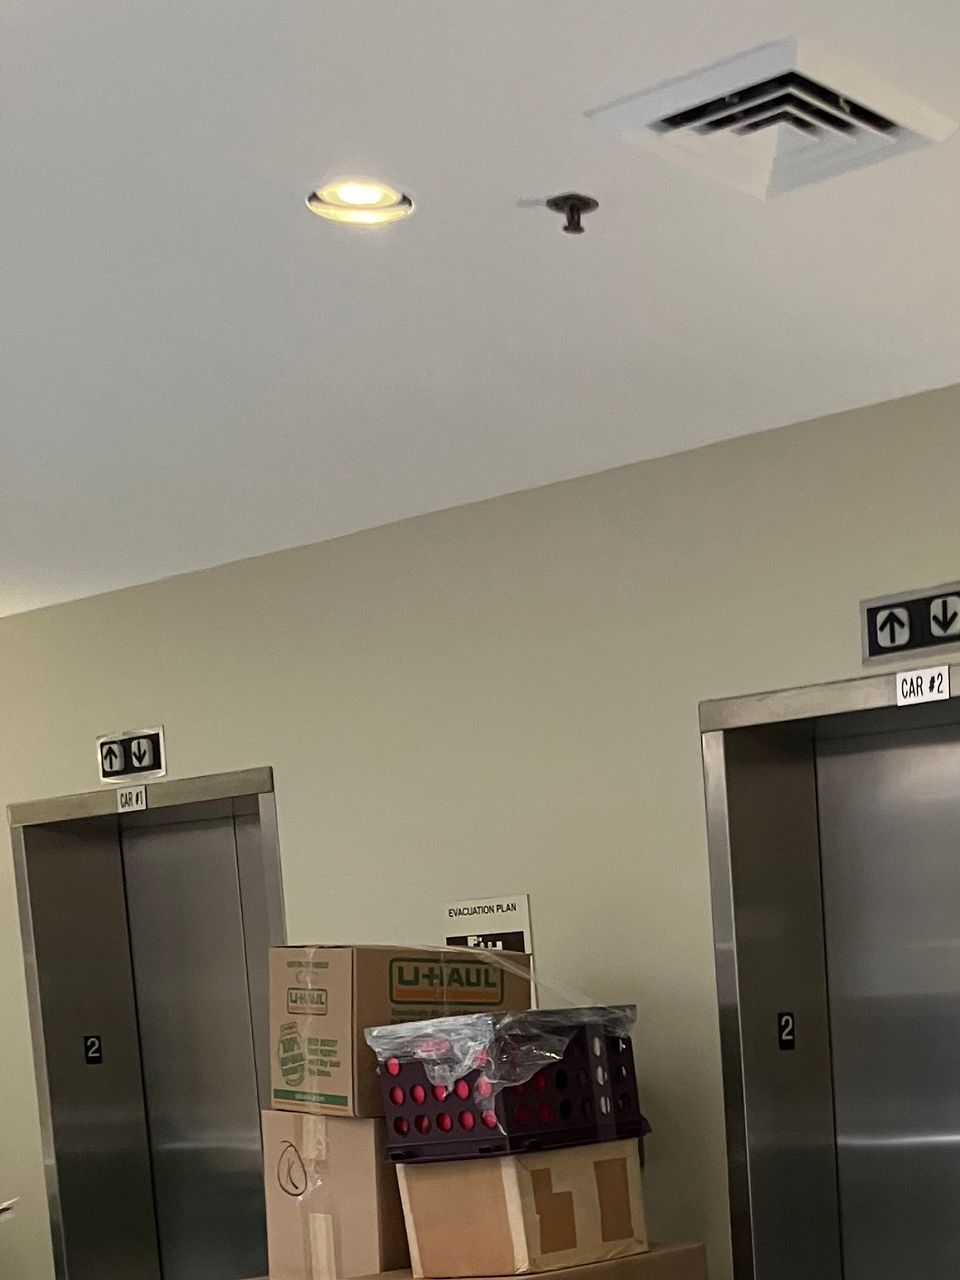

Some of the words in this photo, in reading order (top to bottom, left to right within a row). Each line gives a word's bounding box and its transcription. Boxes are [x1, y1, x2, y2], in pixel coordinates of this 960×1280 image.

[901, 676, 924, 699] CAR
[928, 673, 944, 693] #2
[120, 791, 134, 808] CAR
[448, 905, 495, 918] EVACUATION
[496, 902, 517, 913] PLAN
[781, 1015, 794, 1040] 2
[87, 1037, 100, 1057] 2
